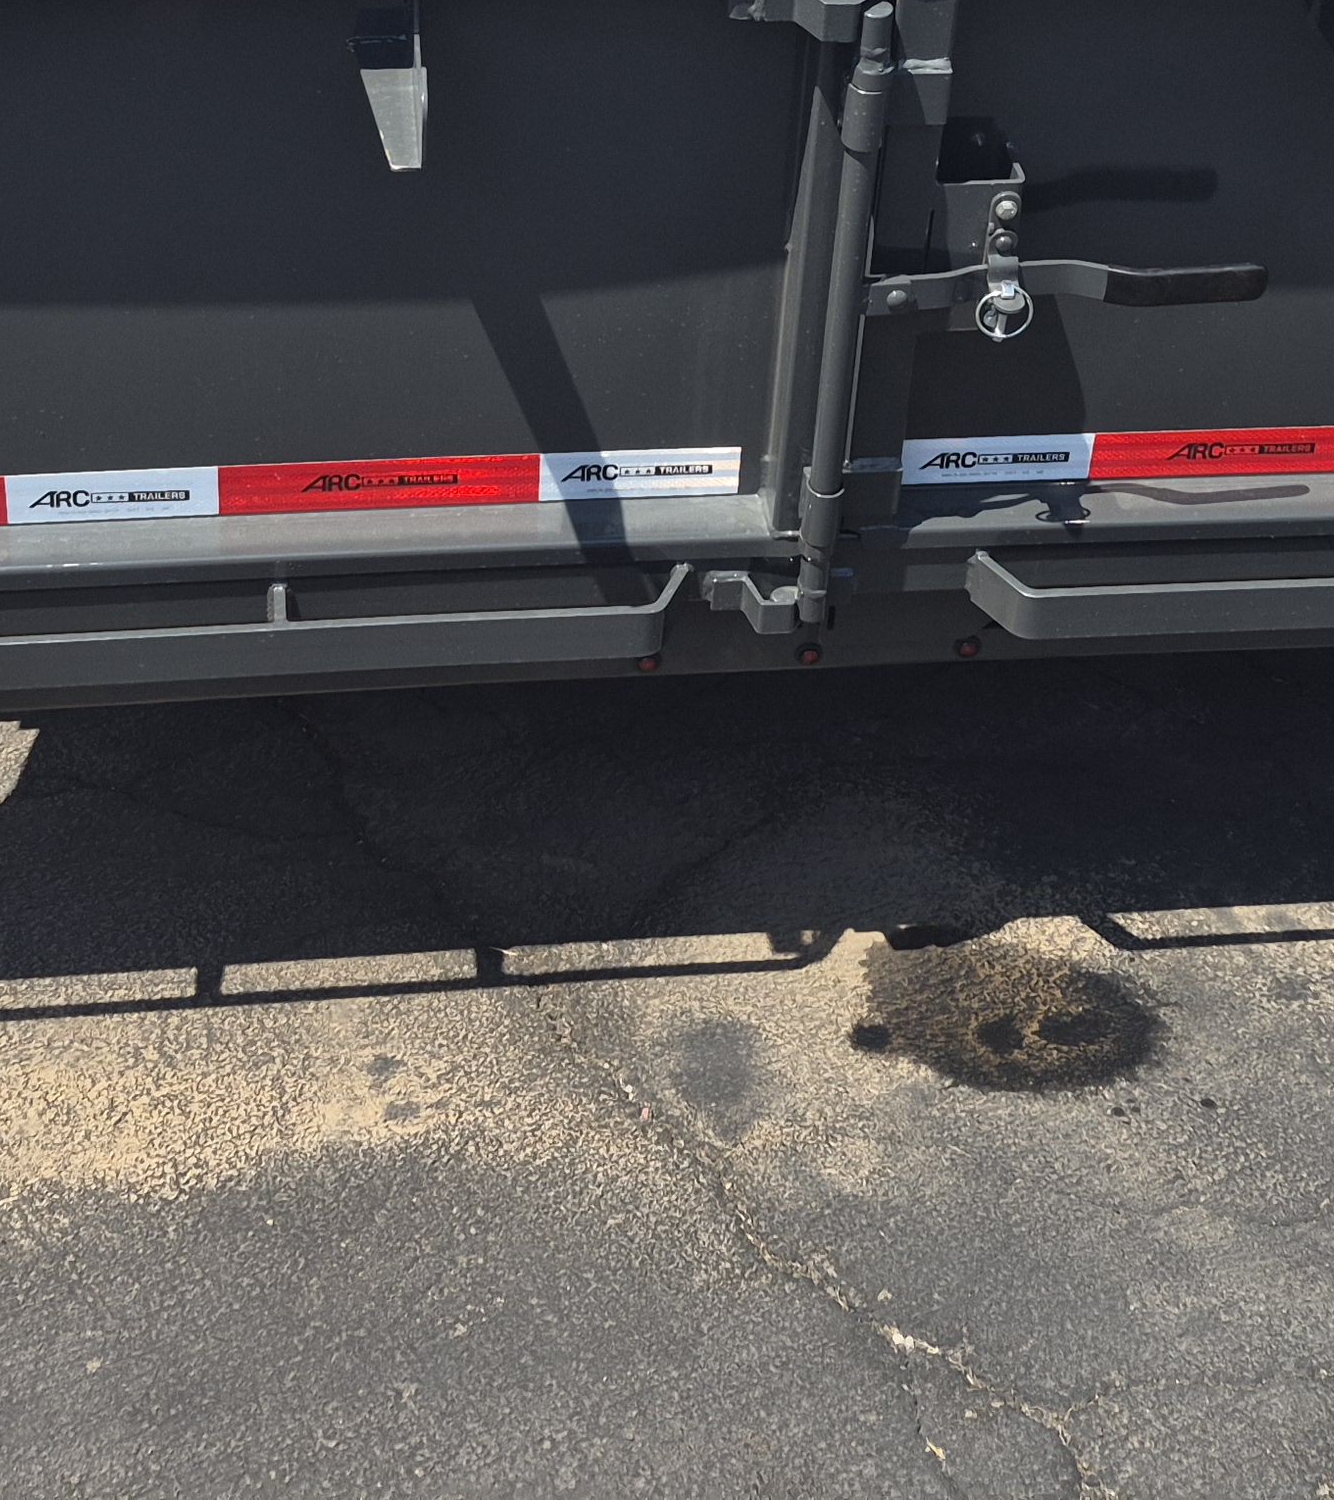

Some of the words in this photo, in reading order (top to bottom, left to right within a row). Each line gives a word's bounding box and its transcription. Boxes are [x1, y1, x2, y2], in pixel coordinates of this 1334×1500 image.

[1166, 442, 1225, 460] ARC
[1263, 444, 1312, 453] TRAILERS
[919, 451, 978, 470] ARC
[1016, 453, 1066, 463] TRAILERS
[560, 464, 619, 482] ARC
[659, 465, 709, 475] TRAILERS
[301, 473, 362, 492] ARC
[29, 490, 91, 508] ARC
[133, 491, 187, 501] TRAILERS
